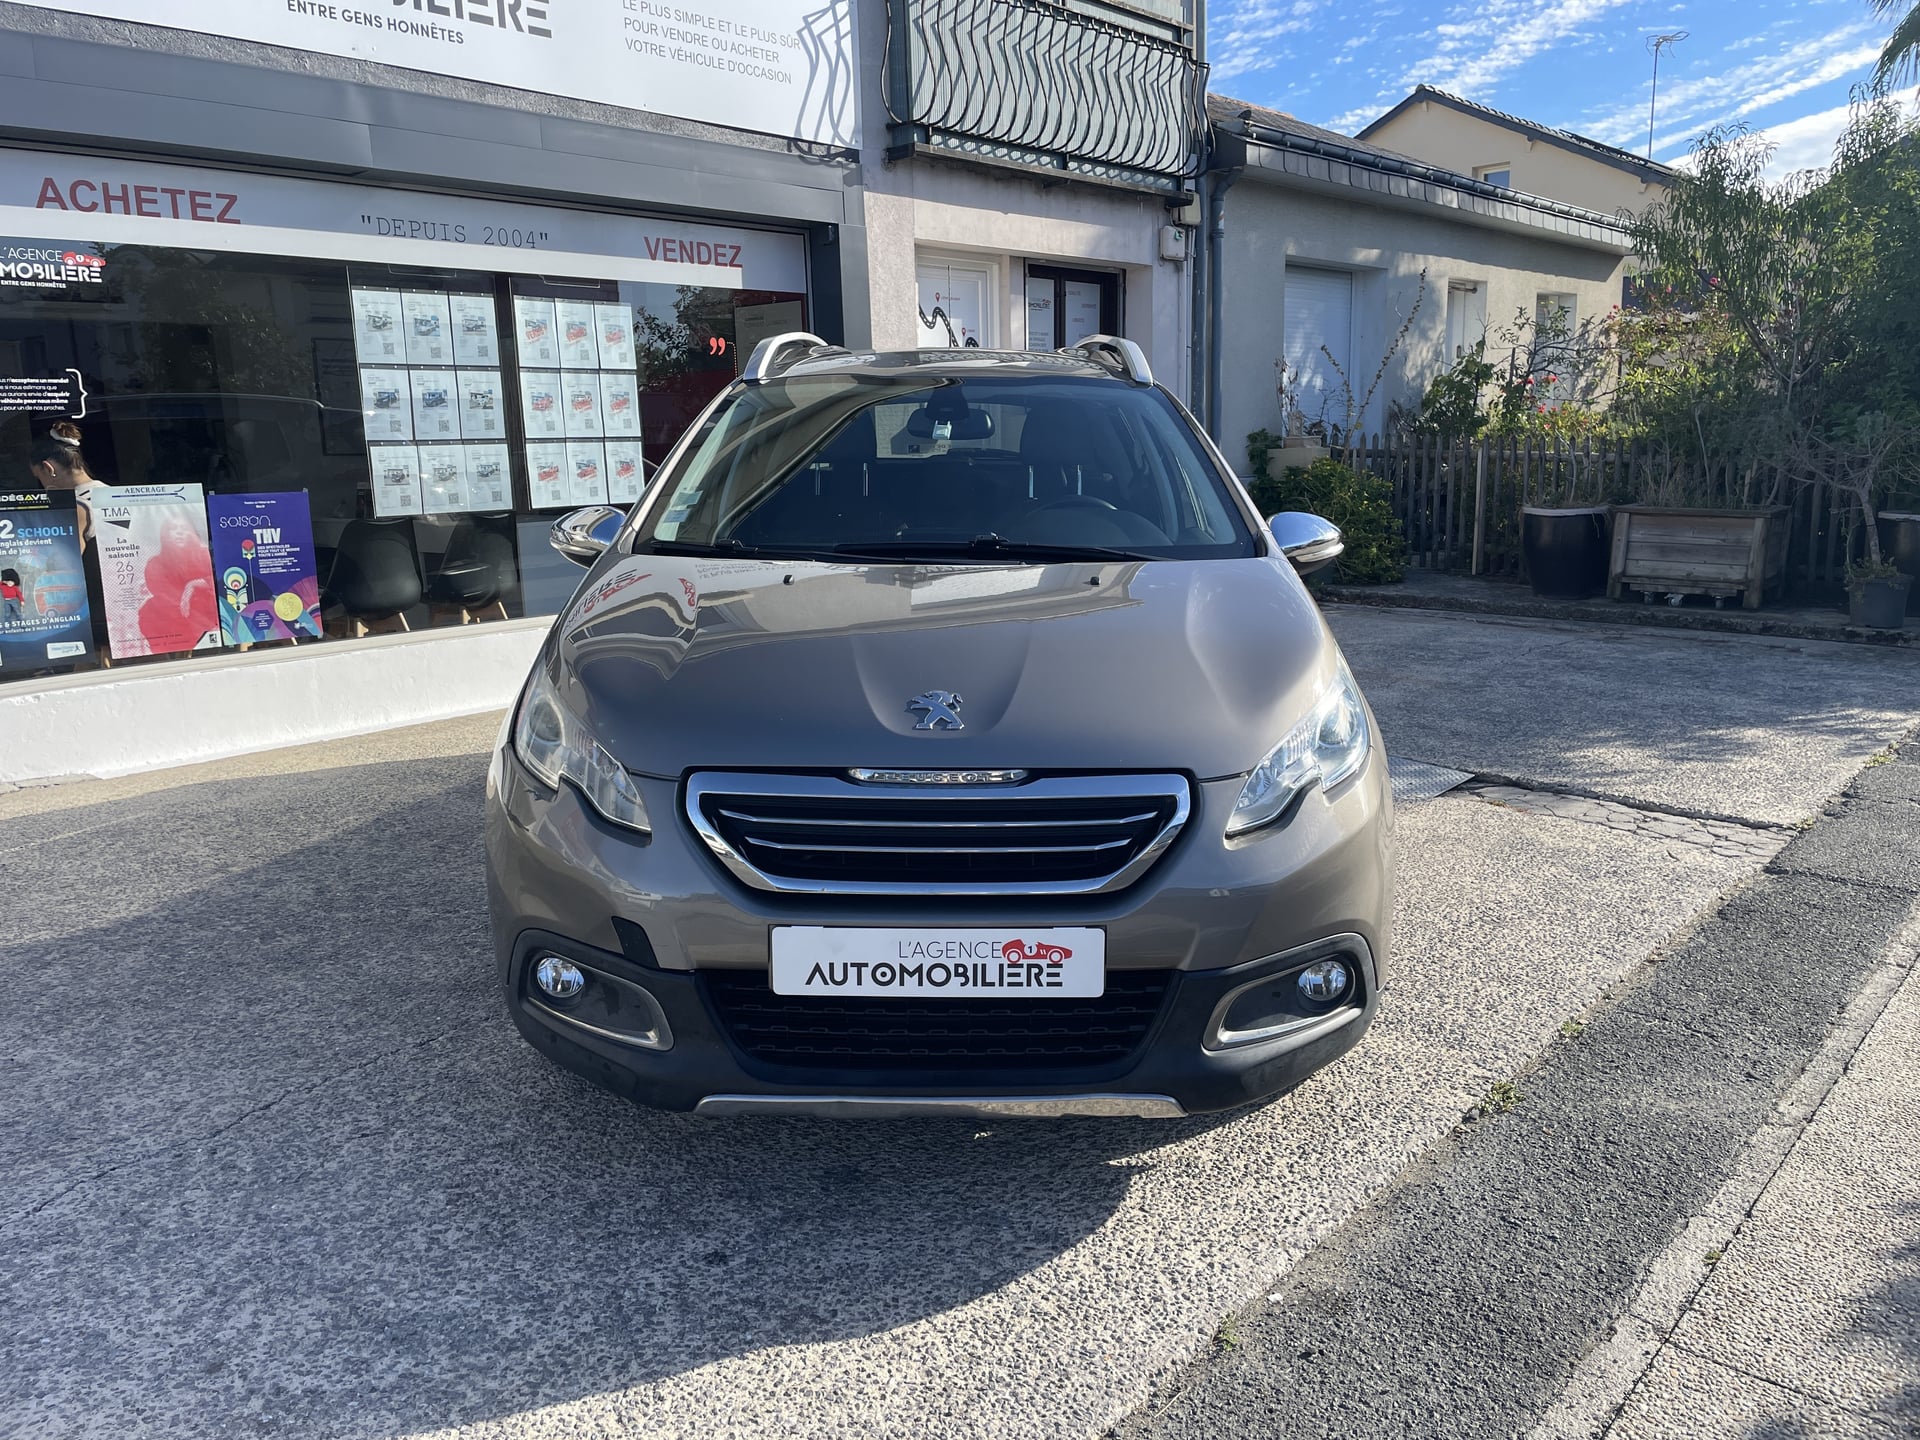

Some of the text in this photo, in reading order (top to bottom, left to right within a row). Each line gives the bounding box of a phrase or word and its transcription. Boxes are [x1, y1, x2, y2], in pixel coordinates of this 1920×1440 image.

[287, 0, 464, 44] ENTRE GENS HONNÊTES
[622, 0, 801, 50] LE PLUS SIMPLE ET LE PLUS SÛR
[624, 17, 780, 63] POUR VENDRE OU ACHETER
[625, 37, 792, 85] VOTRE VÉHICULE D'OCCASION
[36, 177, 241, 224] ACHETEZ
[361, 215, 548, 248] "DEPUIS 2004"
[644, 236, 743, 268] VENDEZ
[18, 526, 67, 537] SCHOOL
[25, 538, 52, 546] devient
[253, 527, 281, 544] THV
[105, 544, 140, 552] nouvelle
[116, 561, 134, 573] 26
[117, 573, 135, 585] 27
[11, 618, 41, 627] STAGES
[42, 615, 81, 625] D'ANGLAIS
[898, 941, 1002, 959] L'AGENCE
[805, 962, 1063, 987] AUTOMOBILIERE
